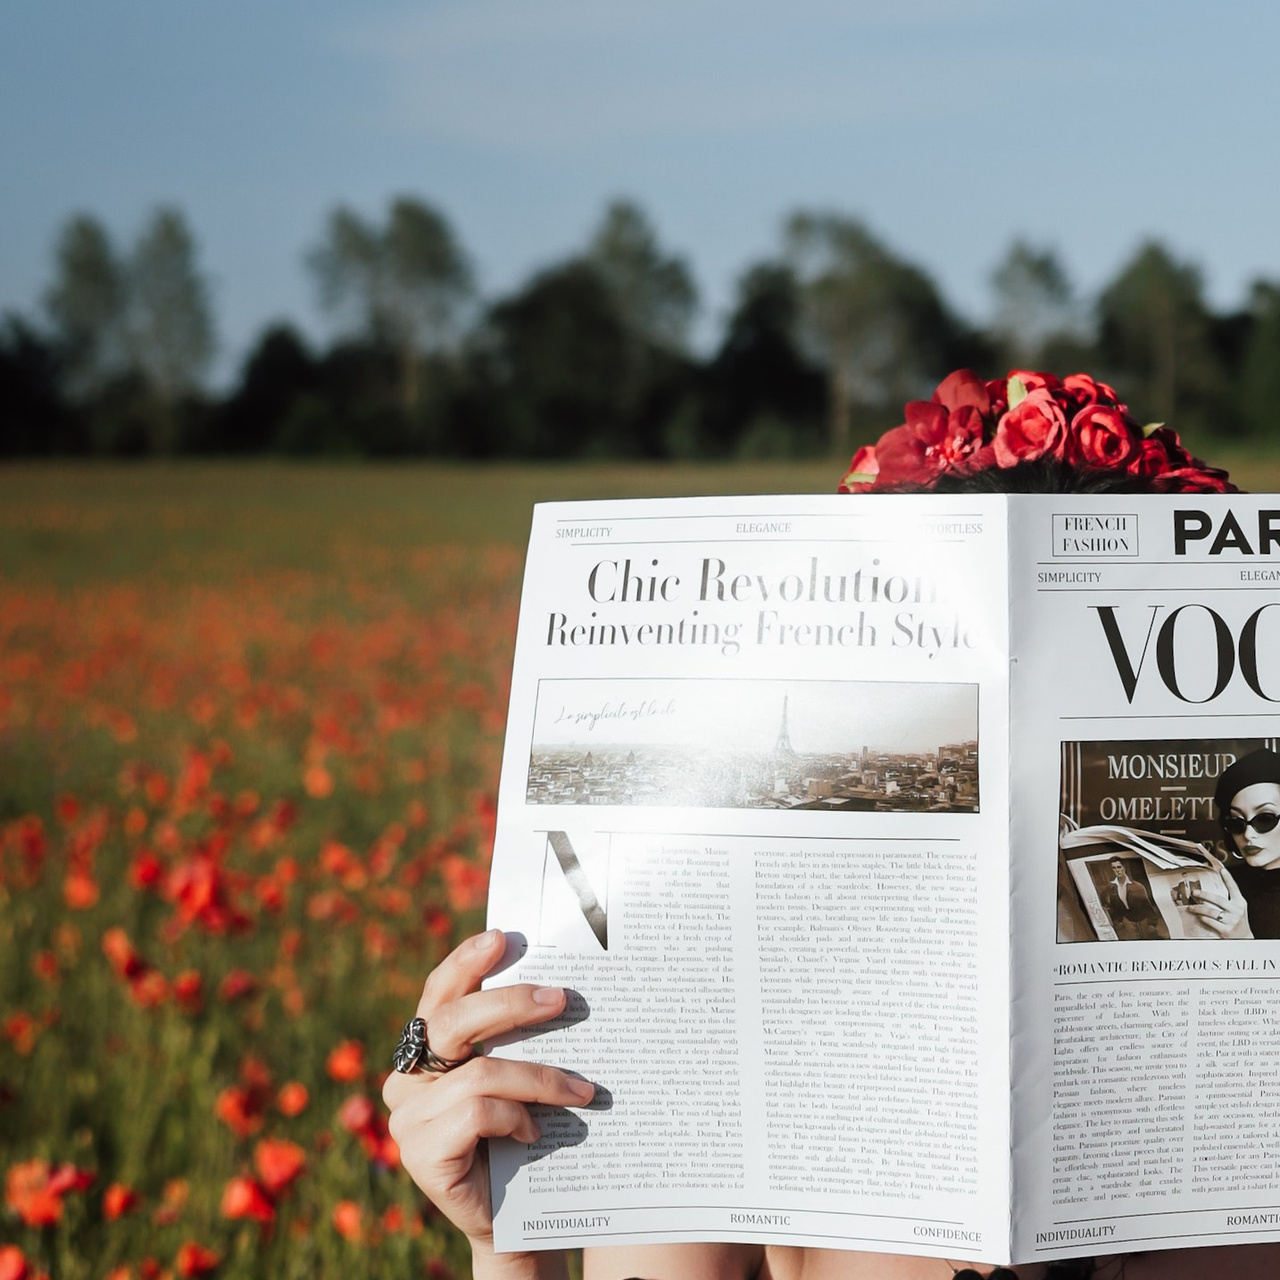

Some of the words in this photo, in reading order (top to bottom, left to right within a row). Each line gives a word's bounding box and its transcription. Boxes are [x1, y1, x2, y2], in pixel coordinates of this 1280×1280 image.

[555, 526, 613, 539] SIMPLICITY
[736, 522, 792, 535] ELEGANCE
[1064, 516, 1126, 531] FRENCH
[1063, 537, 1129, 552] FASHION
[587, 558, 681, 604] Chic
[1037, 571, 1102, 584] SIMPLICITY
[546, 610, 744, 656] Reinventing
[755, 609, 877, 647] French
[890, 612, 981, 660] Style
[1131, 959, 1222, 972] RENDEZVOUS:
[1226, 959, 1259, 971] FALL
[1263, 959, 1277, 971] IN
[522, 1216, 611, 1231] INDIVIDUALITY
[730, 1213, 793, 1226] ROMANTIC
[912, 1226, 982, 1243] CONFIDENCE
[1035, 1225, 1117, 1244] INDIVIDUALITY
